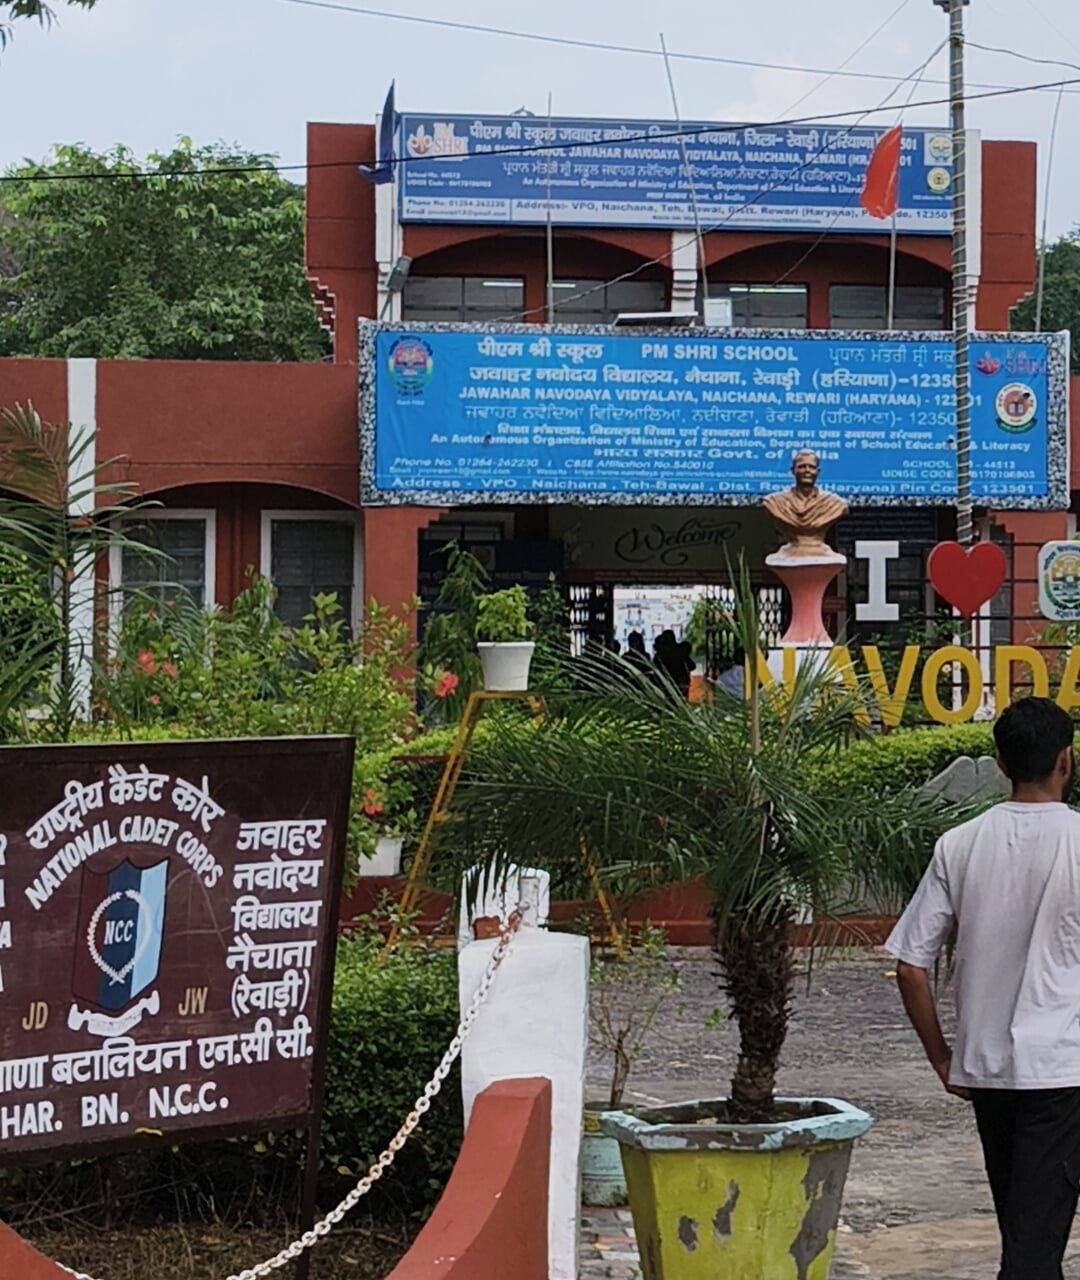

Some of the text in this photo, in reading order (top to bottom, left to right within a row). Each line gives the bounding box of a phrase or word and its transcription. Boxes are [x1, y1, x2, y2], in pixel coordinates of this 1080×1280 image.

[470, 121, 503, 140] पीएम
[505, 122, 521, 140] श्री
[524, 126, 556, 145] स्कूल
[559, 126, 600, 143] जवाहर
[569, 146, 621, 158] JAWAHAR
[624, 148, 680, 160] NAVODAYA
[684, 150, 743, 163] VIDYALAYA,
[745, 152, 803, 164] NAICHANA,
[477, 336, 605, 364] पीएम श्री स्कूल
[641, 344, 799, 361] PM SHRI SCHOOL
[829, 347, 866, 366] ਪ੍ਰਧਾਨ
[871, 344, 907, 363] ਮੰਤਰੀ
[469, 366, 532, 383] जवाहर
[535, 364, 597, 383] नवोदय
[753, 368, 800, 391] रेवाड़ी
[459, 387, 531, 400] JAWAHAR
[535, 388, 611, 401] NAVODAYA
[616, 389, 699, 404] VIDYALAYA,
[702, 391, 782, 406] NAICHANA,
[786, 392, 840, 405] REWARI
[845, 392, 922, 407] (HARYANA)
[464, 405, 518, 419] ਜਵਾਹਰ
[910, 411, 958, 426] 12350
[431, 433, 448, 444] An
[615, 436, 628, 446] of
[631, 436, 681, 448] Ministry
[685, 437, 698, 447] of
[701, 437, 766, 449] Education,
[769, 438, 841, 450] Department
[844, 439, 857, 449] of
[861, 439, 902, 449] School
[905, 440, 958, 450] Educatio
[982, 441, 1031, 453] Literacy
[707, 448, 759, 460] Govt.
[765, 450, 785, 460] of
[393, 457, 432, 468] Phone
[564, 459, 594, 469] CBSE
[902, 460, 953, 469] SCHOOL
[391, 477, 462, 488] Address
[901, 483, 926, 493] Pin
[614, 516, 742, 566] Welcome
[855, 539, 899, 621] I
[25, 780, 104, 850] राष्ट्रीय
[108, 763, 170, 805] कैडेट
[171, 775, 226, 833] कोर
[236, 818, 327, 855] जवाहर
[24, 819, 117, 911] NATIONAL
[119, 815, 180, 847] CADET
[175, 831, 224, 889] CORPS
[233, 854, 324, 893] नवोदय
[231, 896, 323, 932] विद्यालय
[104, 920, 135, 947] NCC
[226, 933, 317, 972] नैचाना
[178, 987, 208, 1016] JW
[231, 970, 311, 1018] (रेवाड़ी)
[22, 1001, 49, 1031] JD
[51, 1036, 192, 1085] बटालियन
[1, 1081, 230, 1139] HAR. BN. N.C.C.
